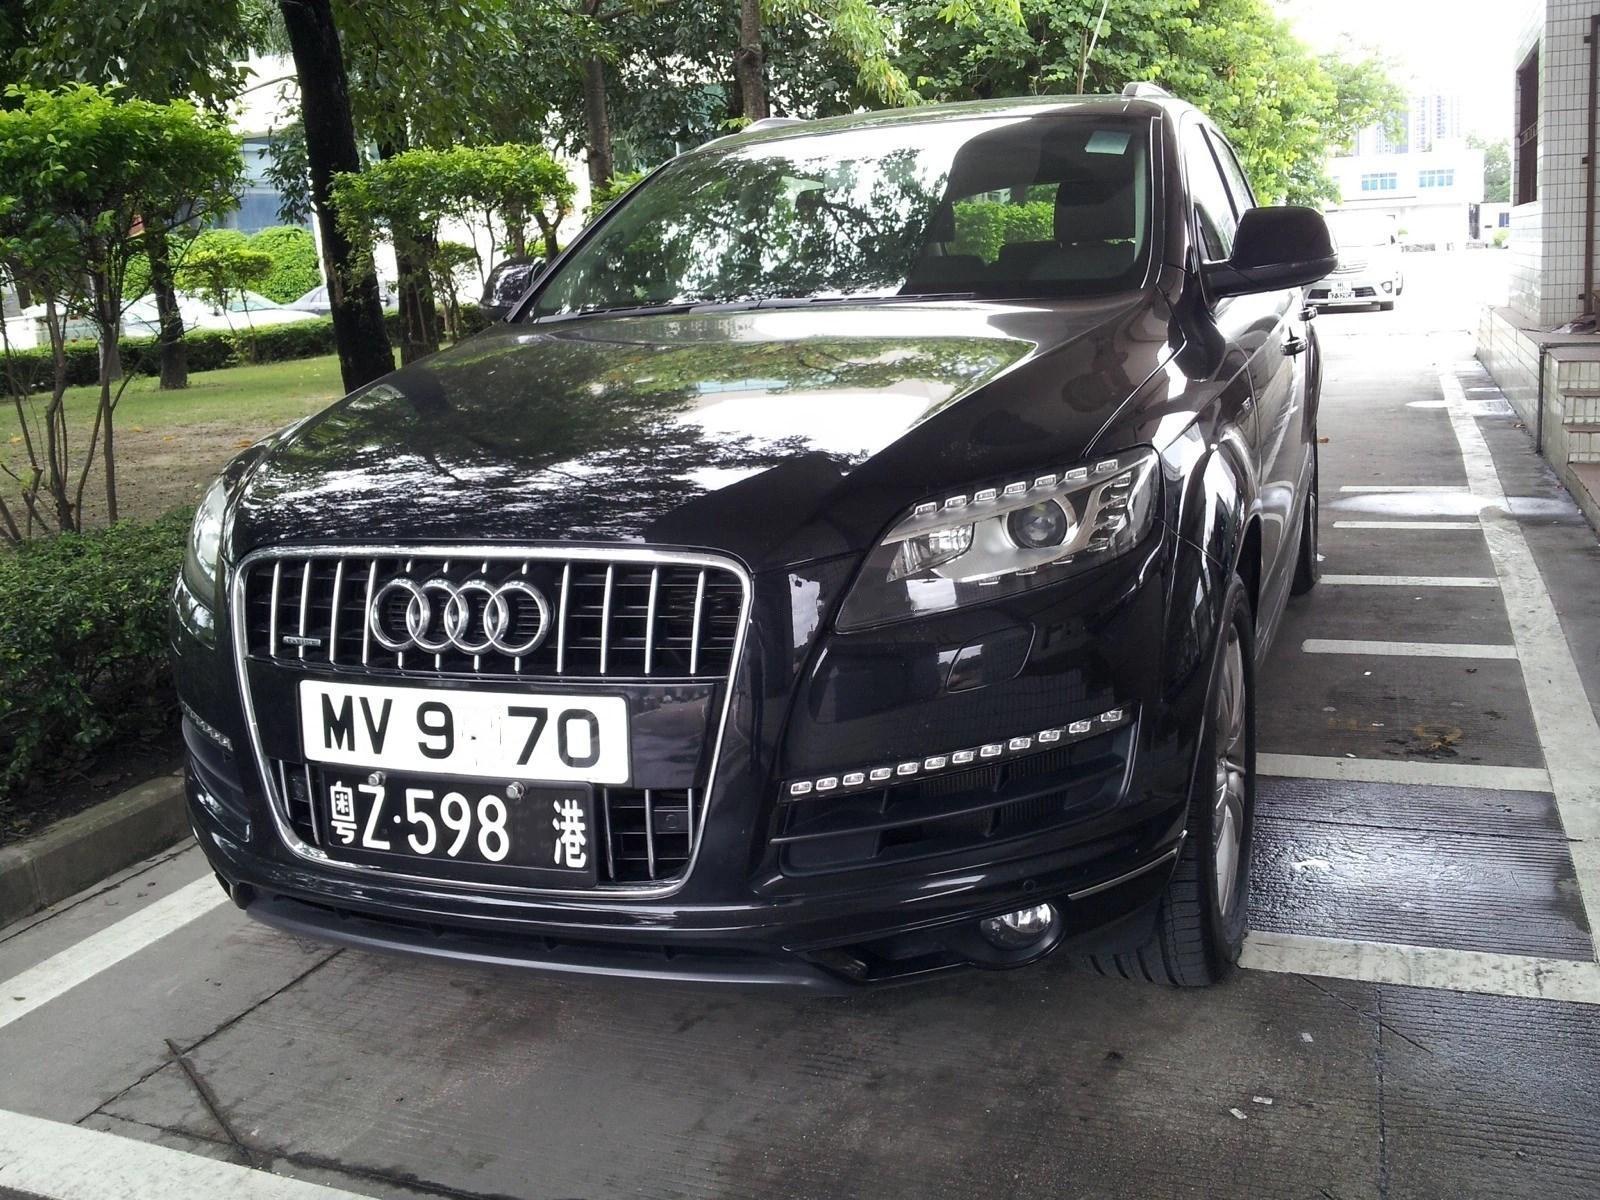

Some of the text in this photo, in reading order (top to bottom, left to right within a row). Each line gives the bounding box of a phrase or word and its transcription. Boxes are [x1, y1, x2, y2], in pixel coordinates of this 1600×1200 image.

[320, 692, 601, 769] MV 9 70
[552, 798, 587, 868] 港
